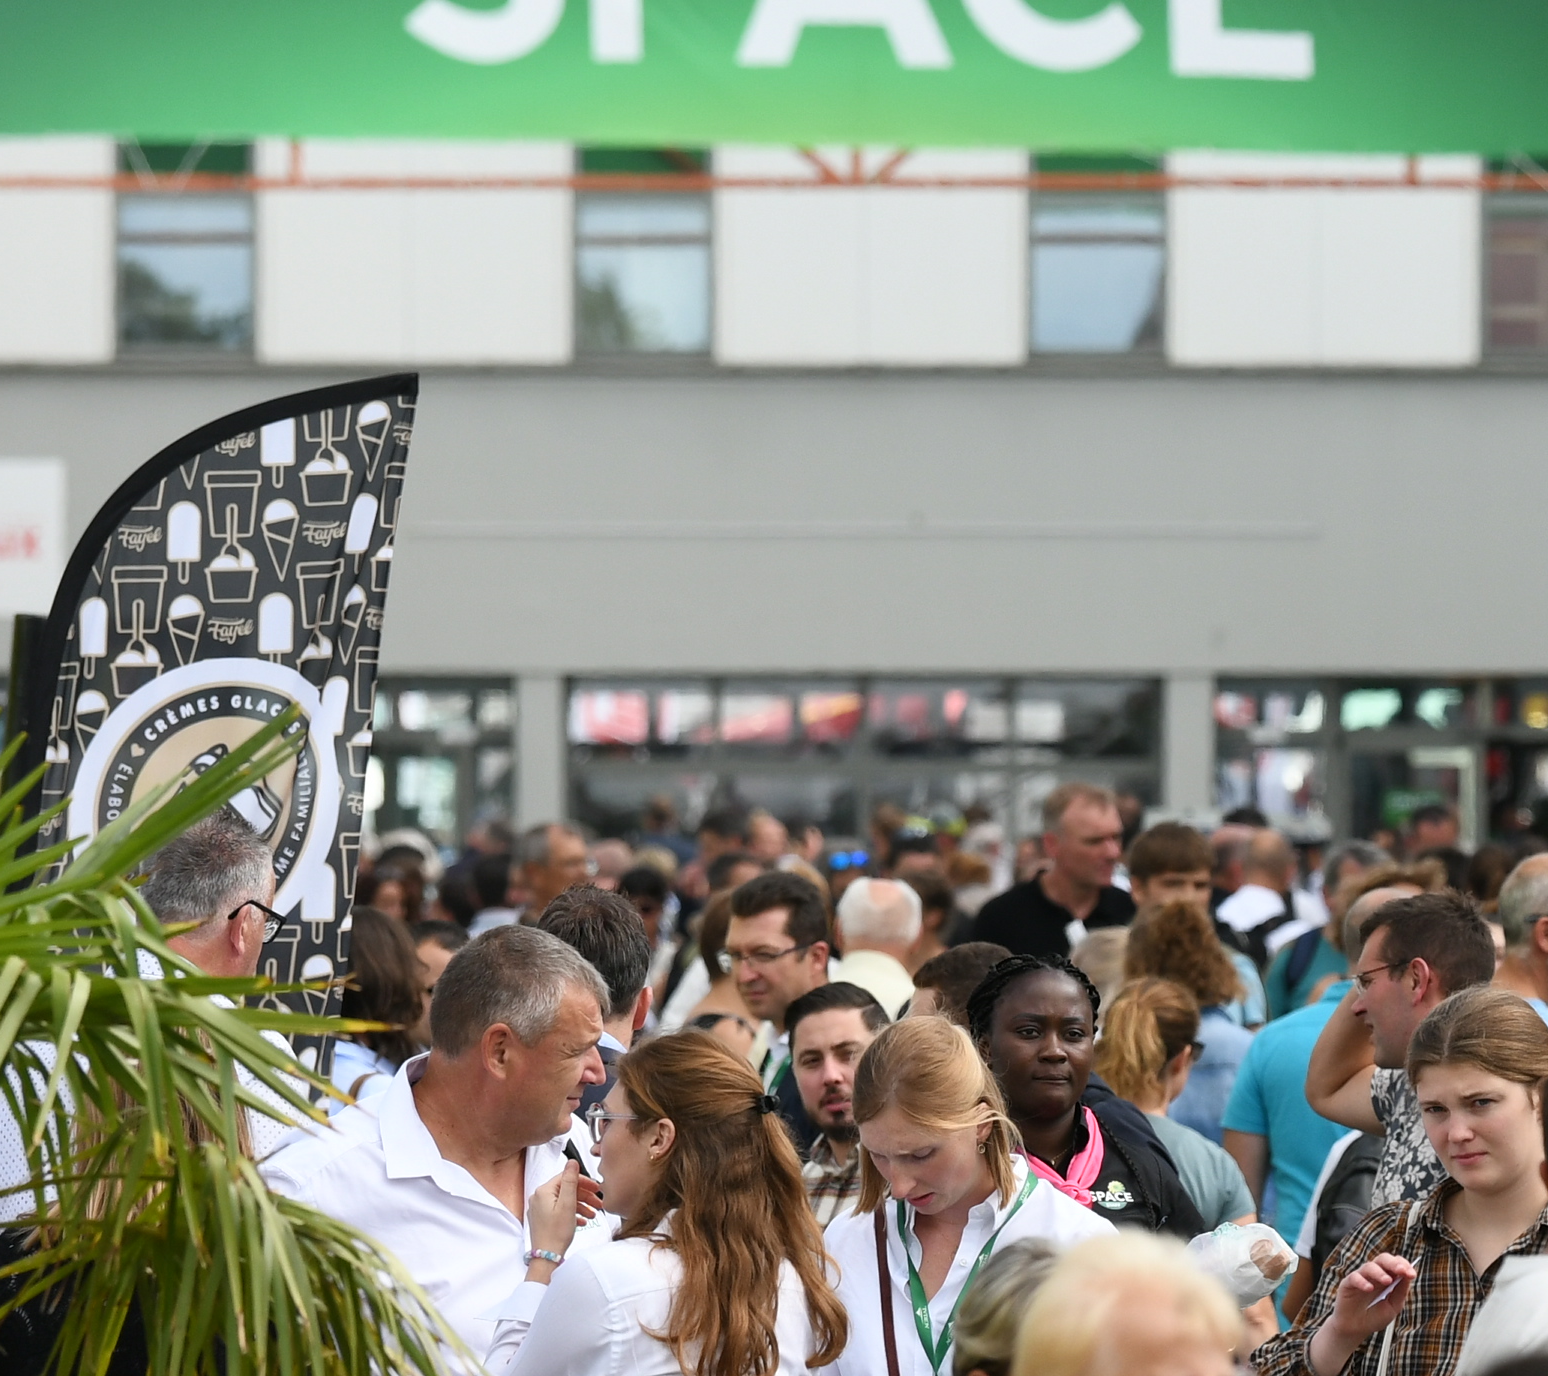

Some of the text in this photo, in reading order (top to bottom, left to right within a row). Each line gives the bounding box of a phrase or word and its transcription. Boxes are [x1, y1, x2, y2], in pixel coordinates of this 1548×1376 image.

[214, 431, 256, 456] ayel
[118, 524, 163, 552] Fayel
[303, 521, 348, 547] Fayel
[207, 617, 254, 644] Fayel
[144, 695, 219, 742] CRÈMES
[1089, 1190, 1135, 1203] SPACE
